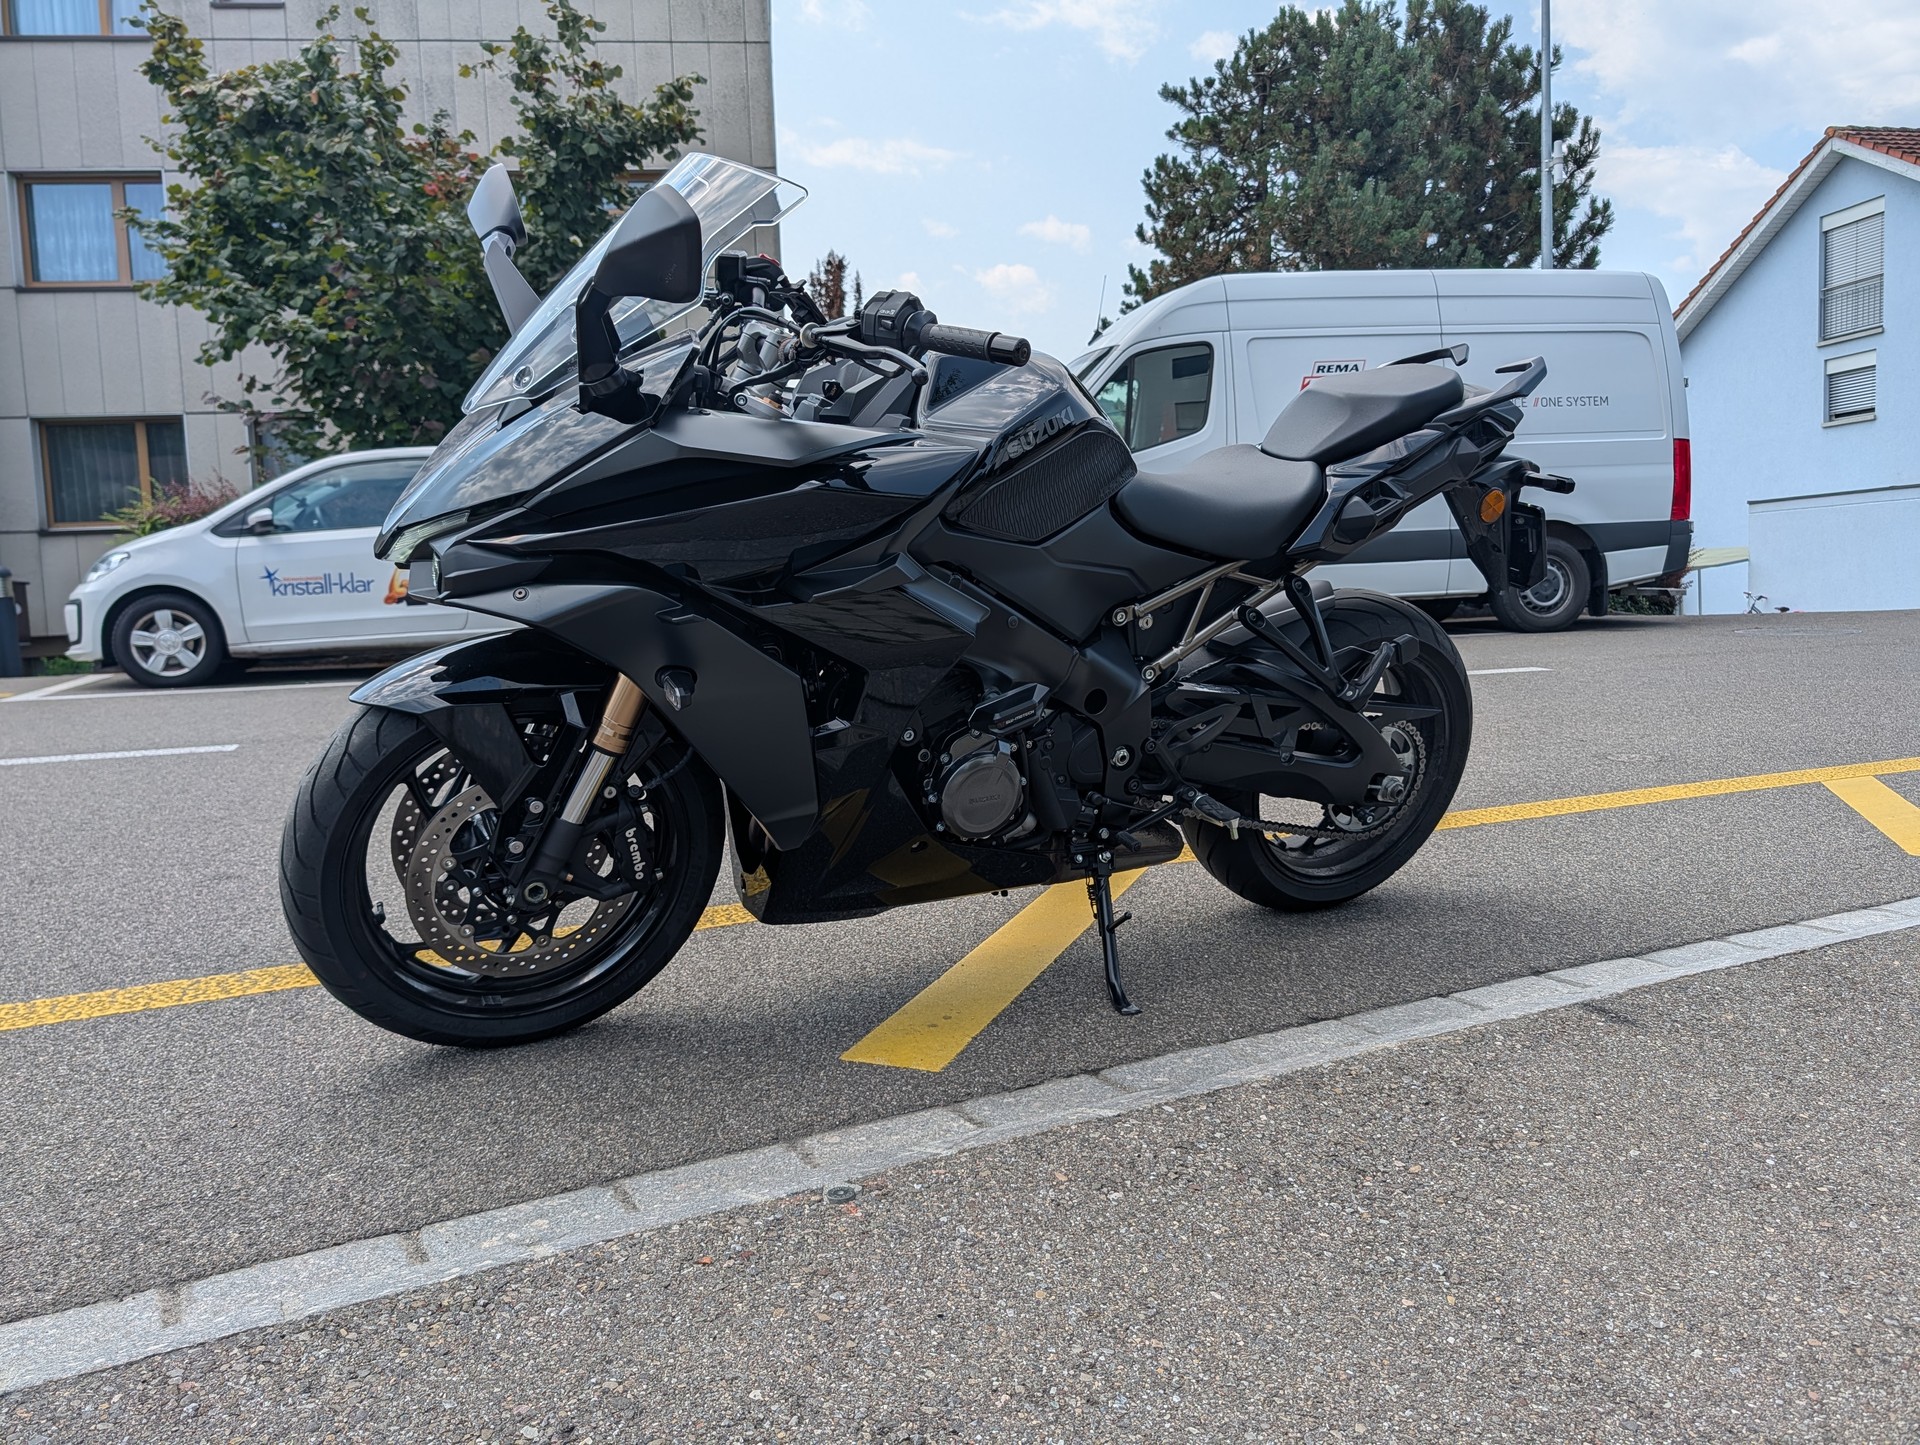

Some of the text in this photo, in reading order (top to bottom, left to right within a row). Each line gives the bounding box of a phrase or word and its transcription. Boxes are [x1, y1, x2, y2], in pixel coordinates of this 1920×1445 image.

[1316, 363, 1359, 374] REMA
[1566, 395, 1609, 407] SYSTEM
[1007, 405, 1075, 459] SUZUKI
[272, 572, 375, 597] kristall-klar
[625, 827, 646, 880] brembo
